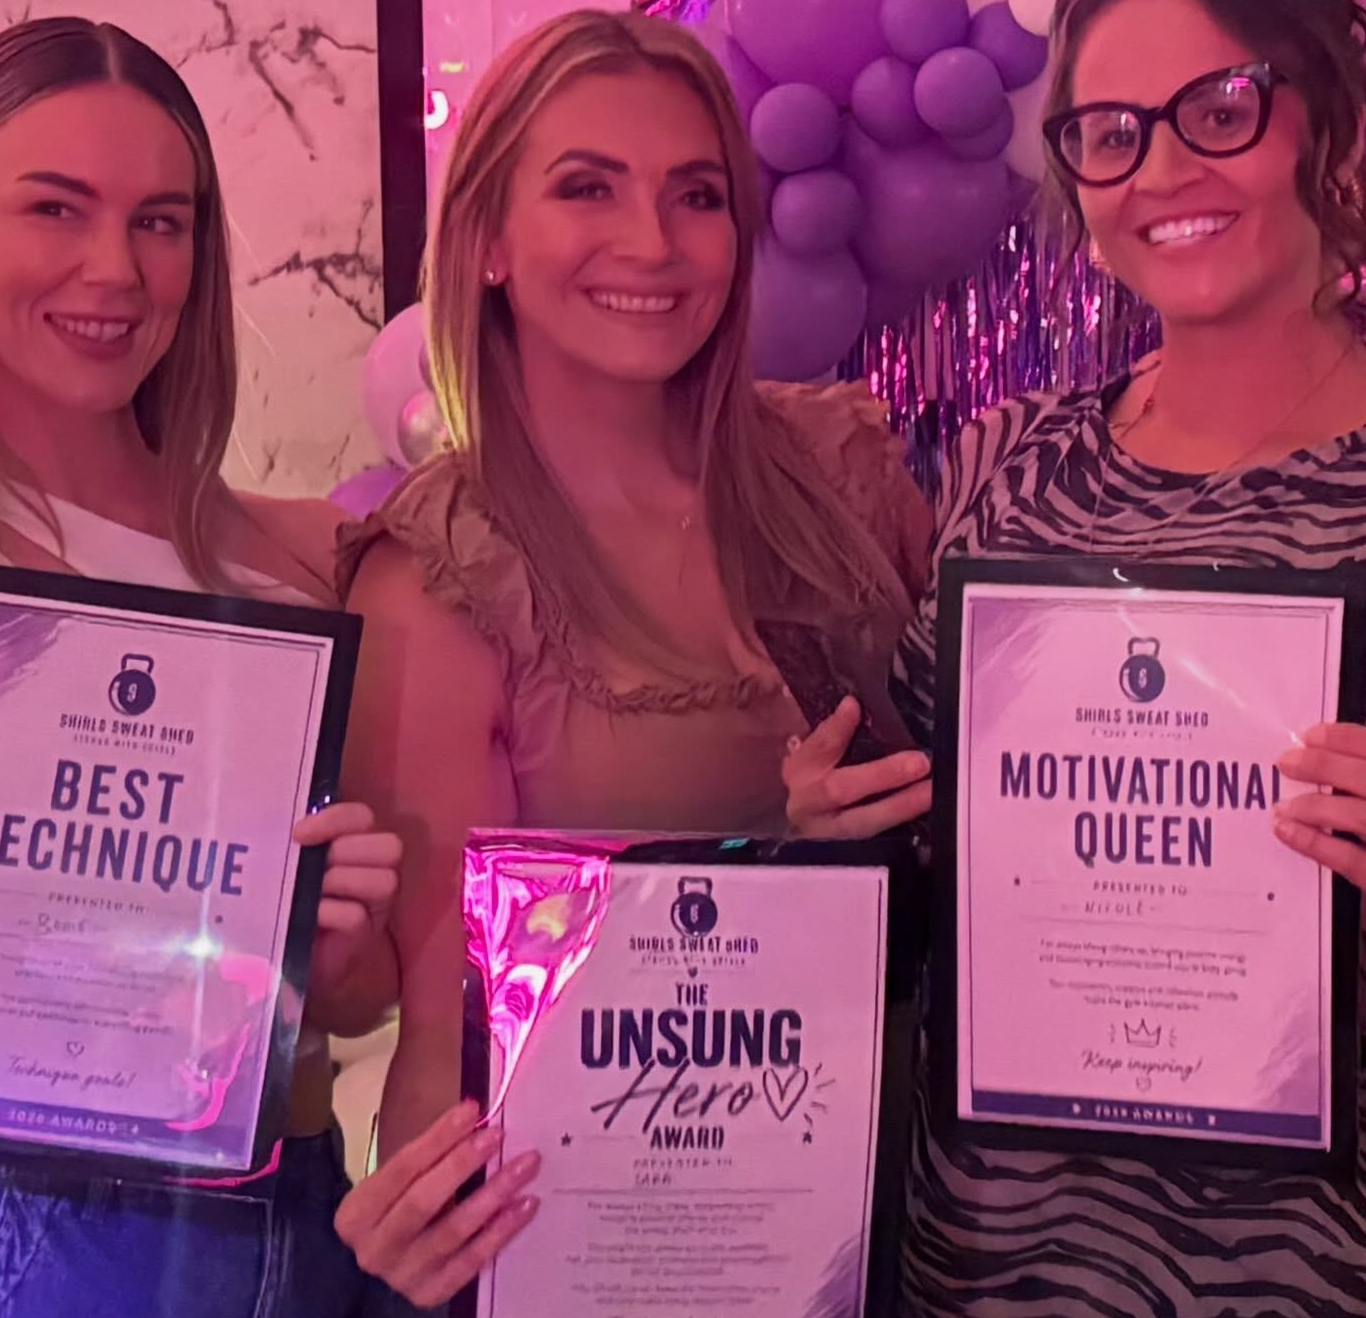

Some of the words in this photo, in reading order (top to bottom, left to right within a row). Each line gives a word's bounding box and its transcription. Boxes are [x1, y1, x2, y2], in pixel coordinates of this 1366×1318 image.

[58, 713, 106, 733] SHIRLS
[111, 719, 155, 740] SWEAT
[159, 726, 195, 745] SHED
[1075, 707, 1122, 724] SHIRLS
[1127, 709, 1170, 727] SWEAT
[1175, 711, 1209, 728] SHED
[51, 758, 184, 825] BEST
[1074, 811, 1212, 868] QUEEN
[629, 936, 675, 953] SHIRLS
[679, 936, 721, 954] SWEAT
[725, 937, 759, 954] SHED
[675, 982, 708, 1007] THE
[580, 1007, 803, 1070] UNSUNG
[8, 1054, 80, 1087] Technique
[81, 1070, 138, 1091] goals!
[1081, 1050, 1123, 1074] Keep
[1127, 1054, 1204, 1082] inspiring!
[590, 1058, 754, 1133] Hero
[649, 1125, 725, 1151] AWARD
